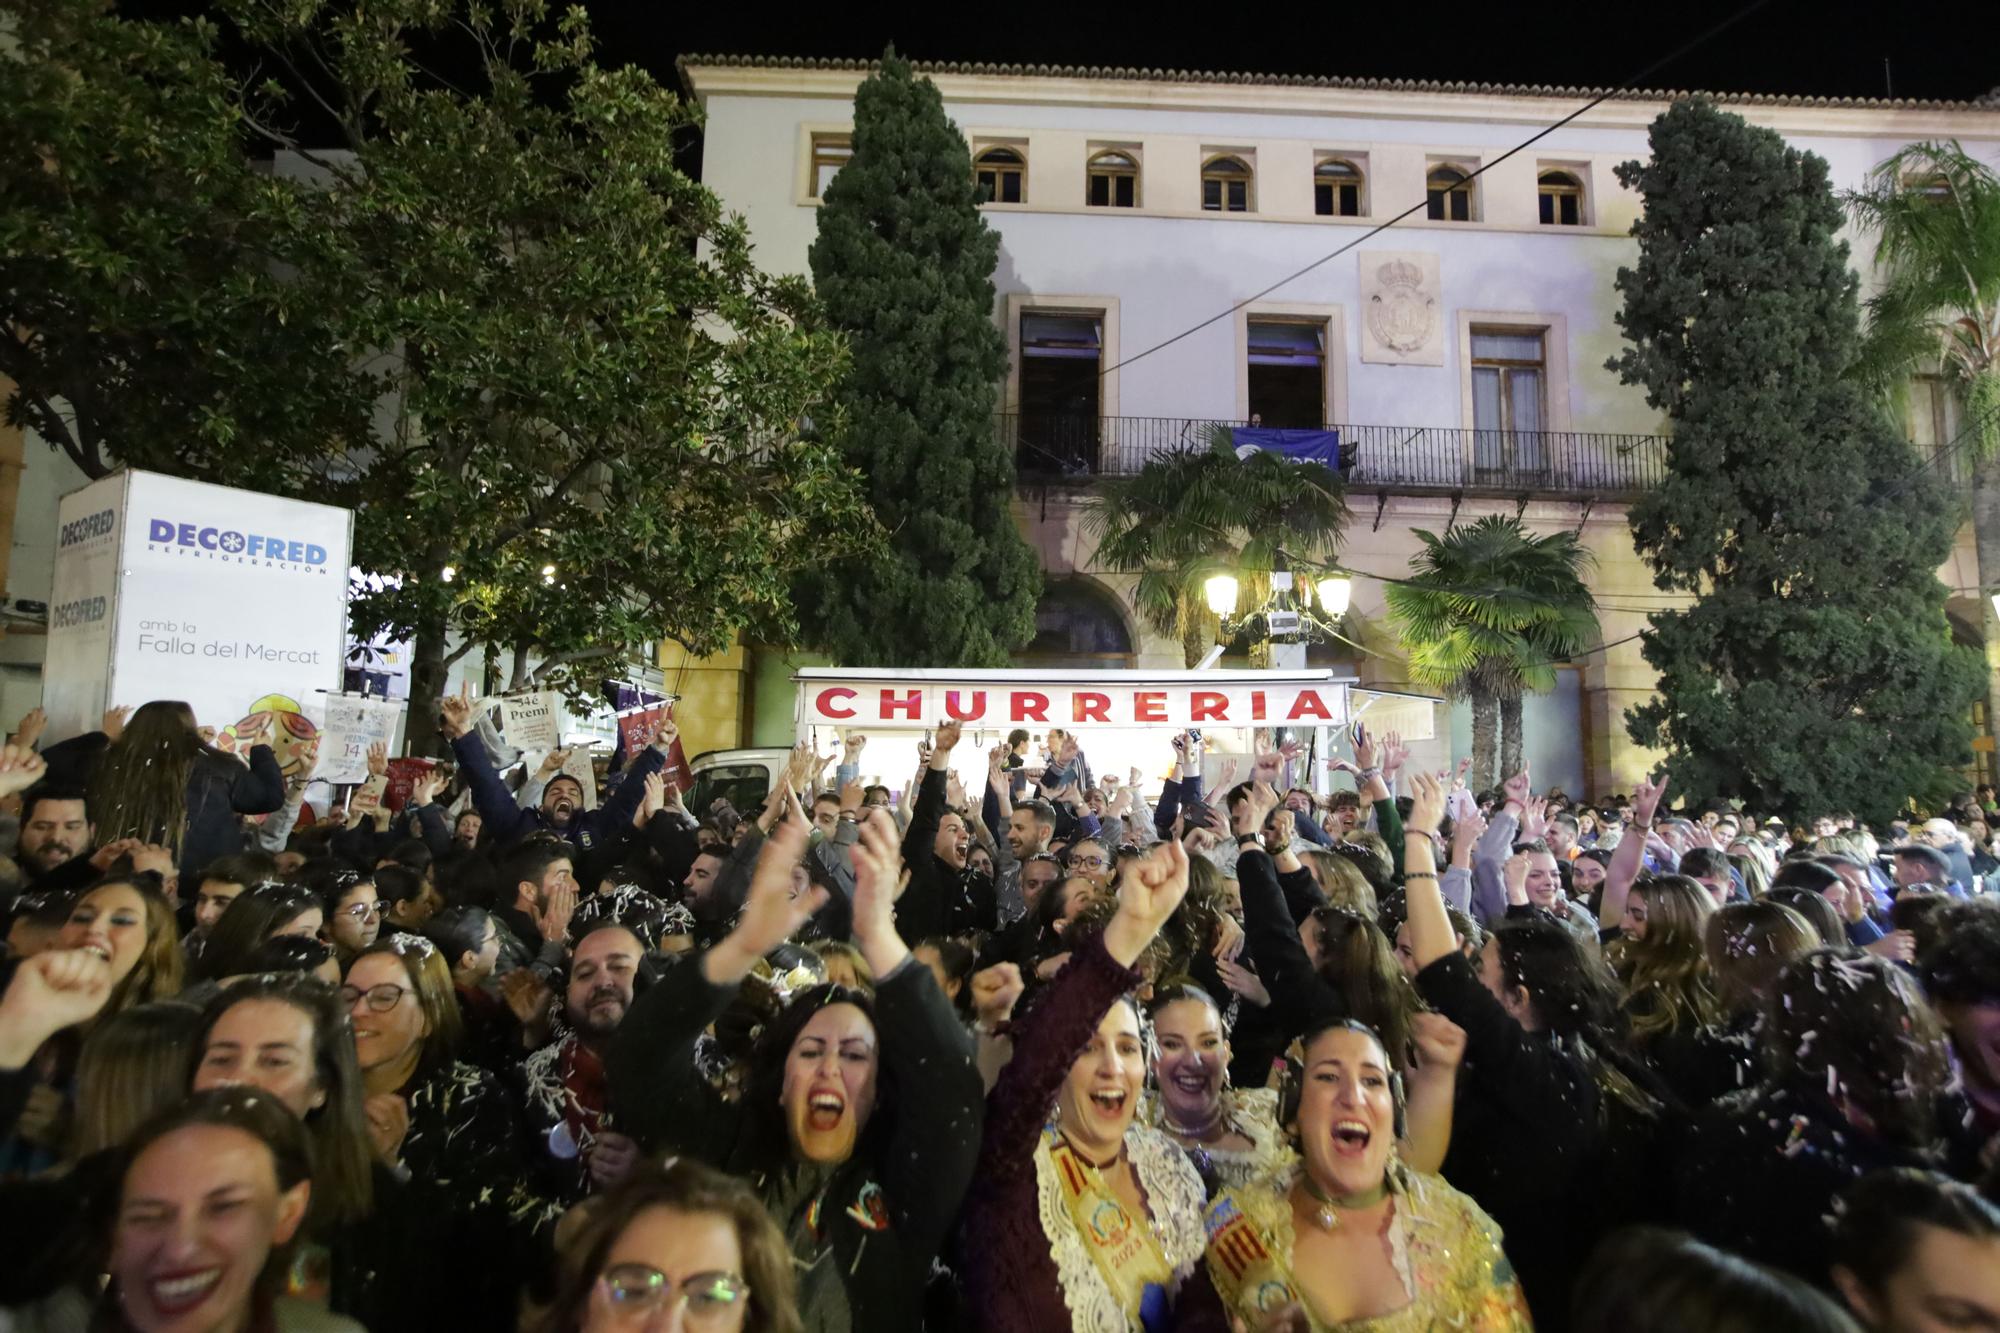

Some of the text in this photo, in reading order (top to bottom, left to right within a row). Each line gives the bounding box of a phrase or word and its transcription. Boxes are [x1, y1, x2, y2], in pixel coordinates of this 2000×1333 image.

[60, 509, 114, 548] DECOFRED
[149, 519, 327, 565] DECOFRED
[148, 544, 326, 575] REFRIGERACIÓN
[139, 619, 197, 634] amb la
[138, 634, 321, 665] Falla del Mercat
[510, 704, 549, 720] Premi
[815, 687, 1333, 723] CHURRERIA
[343, 744, 360, 757] 14
